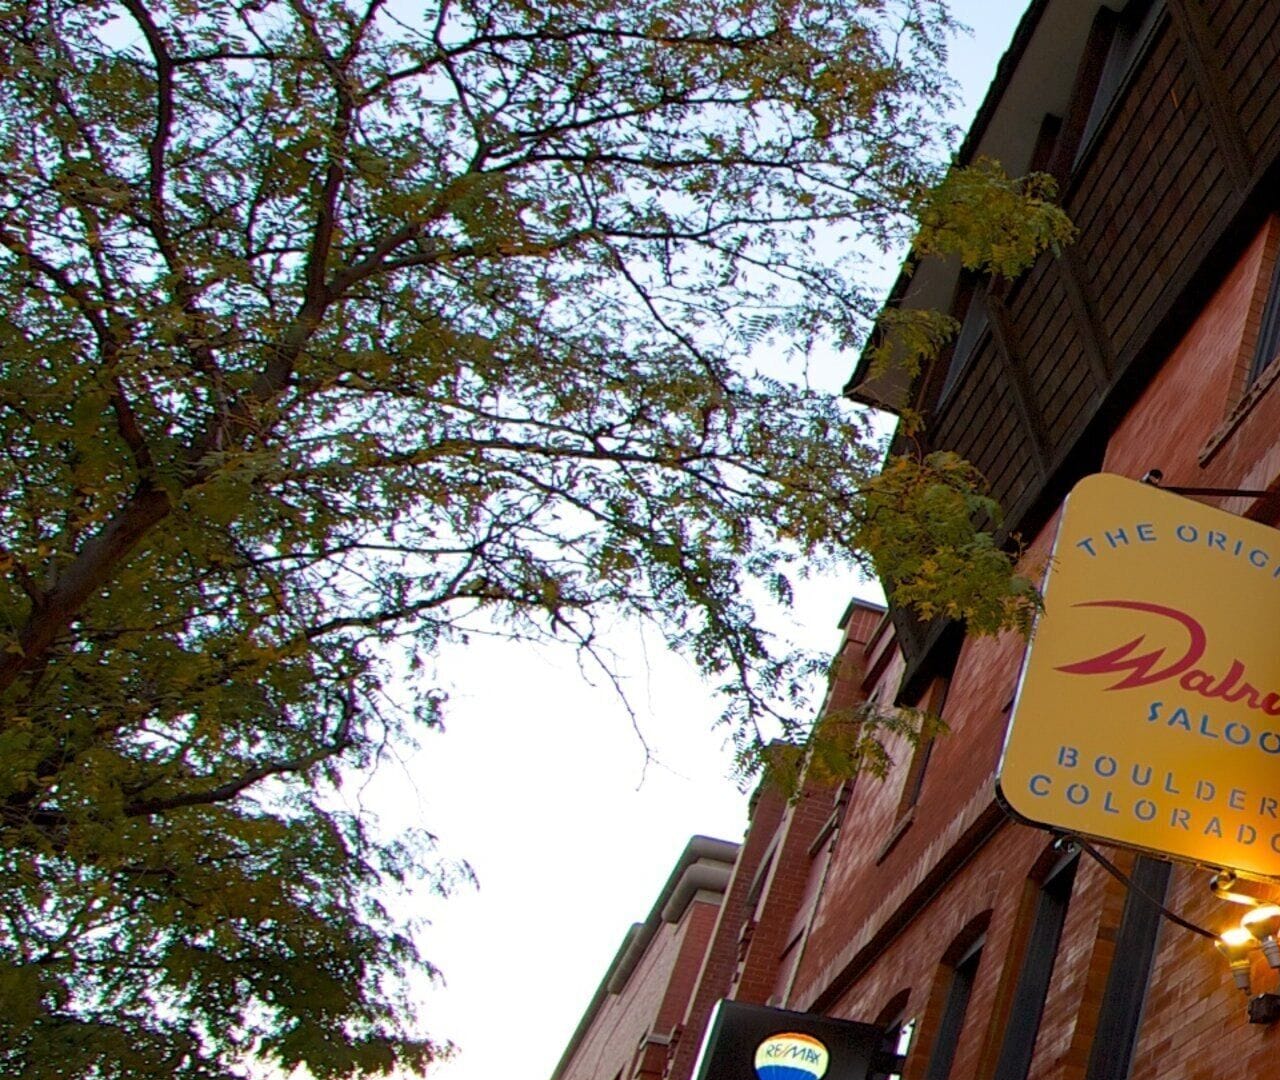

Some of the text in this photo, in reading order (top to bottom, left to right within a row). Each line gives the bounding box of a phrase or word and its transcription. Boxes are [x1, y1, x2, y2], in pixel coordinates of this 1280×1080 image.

[1077, 523, 1156, 558] THE
[1058, 746, 1279, 819] BOULDER
[765, 1044, 822, 1065] RE/MAX
